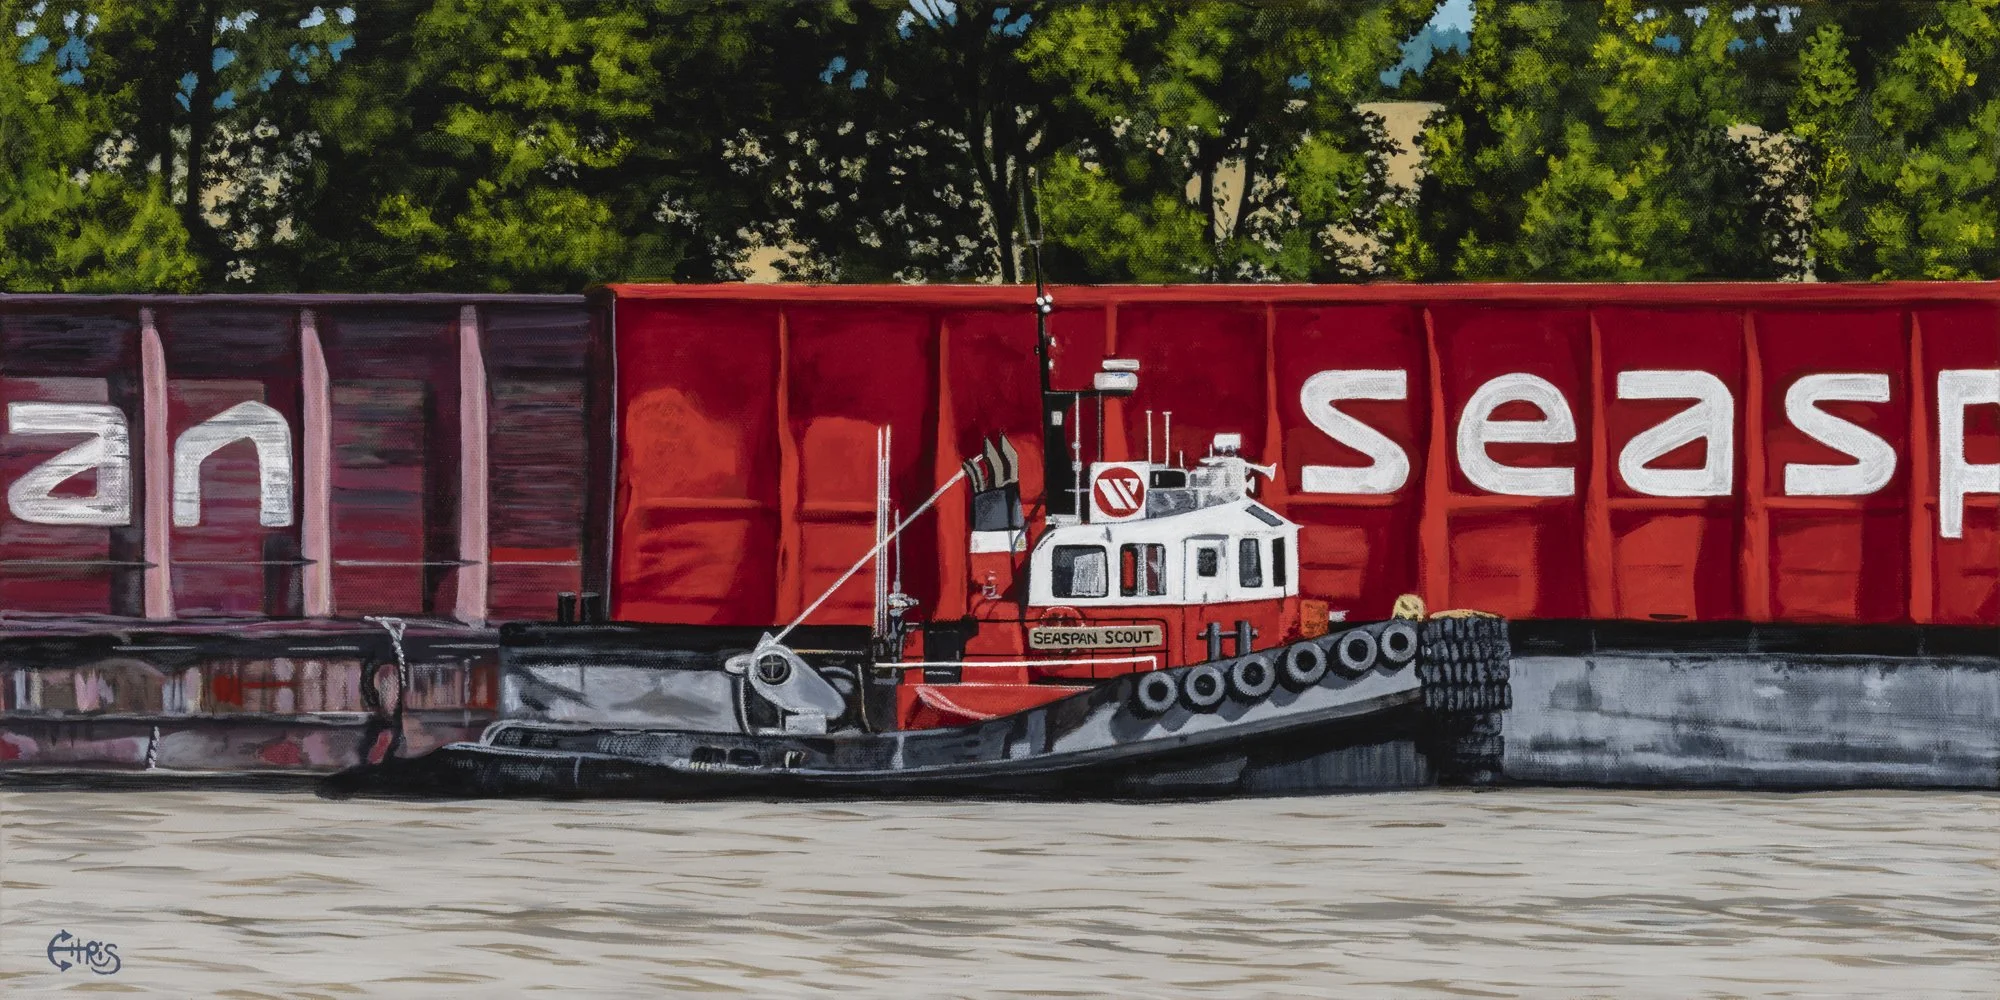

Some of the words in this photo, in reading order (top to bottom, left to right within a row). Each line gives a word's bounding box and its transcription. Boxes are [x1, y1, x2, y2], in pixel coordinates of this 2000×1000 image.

[9, 400, 293, 527] an
[1033, 631, 1098, 645] SEASPAN
[1105, 630, 1154, 644] SCOUT
